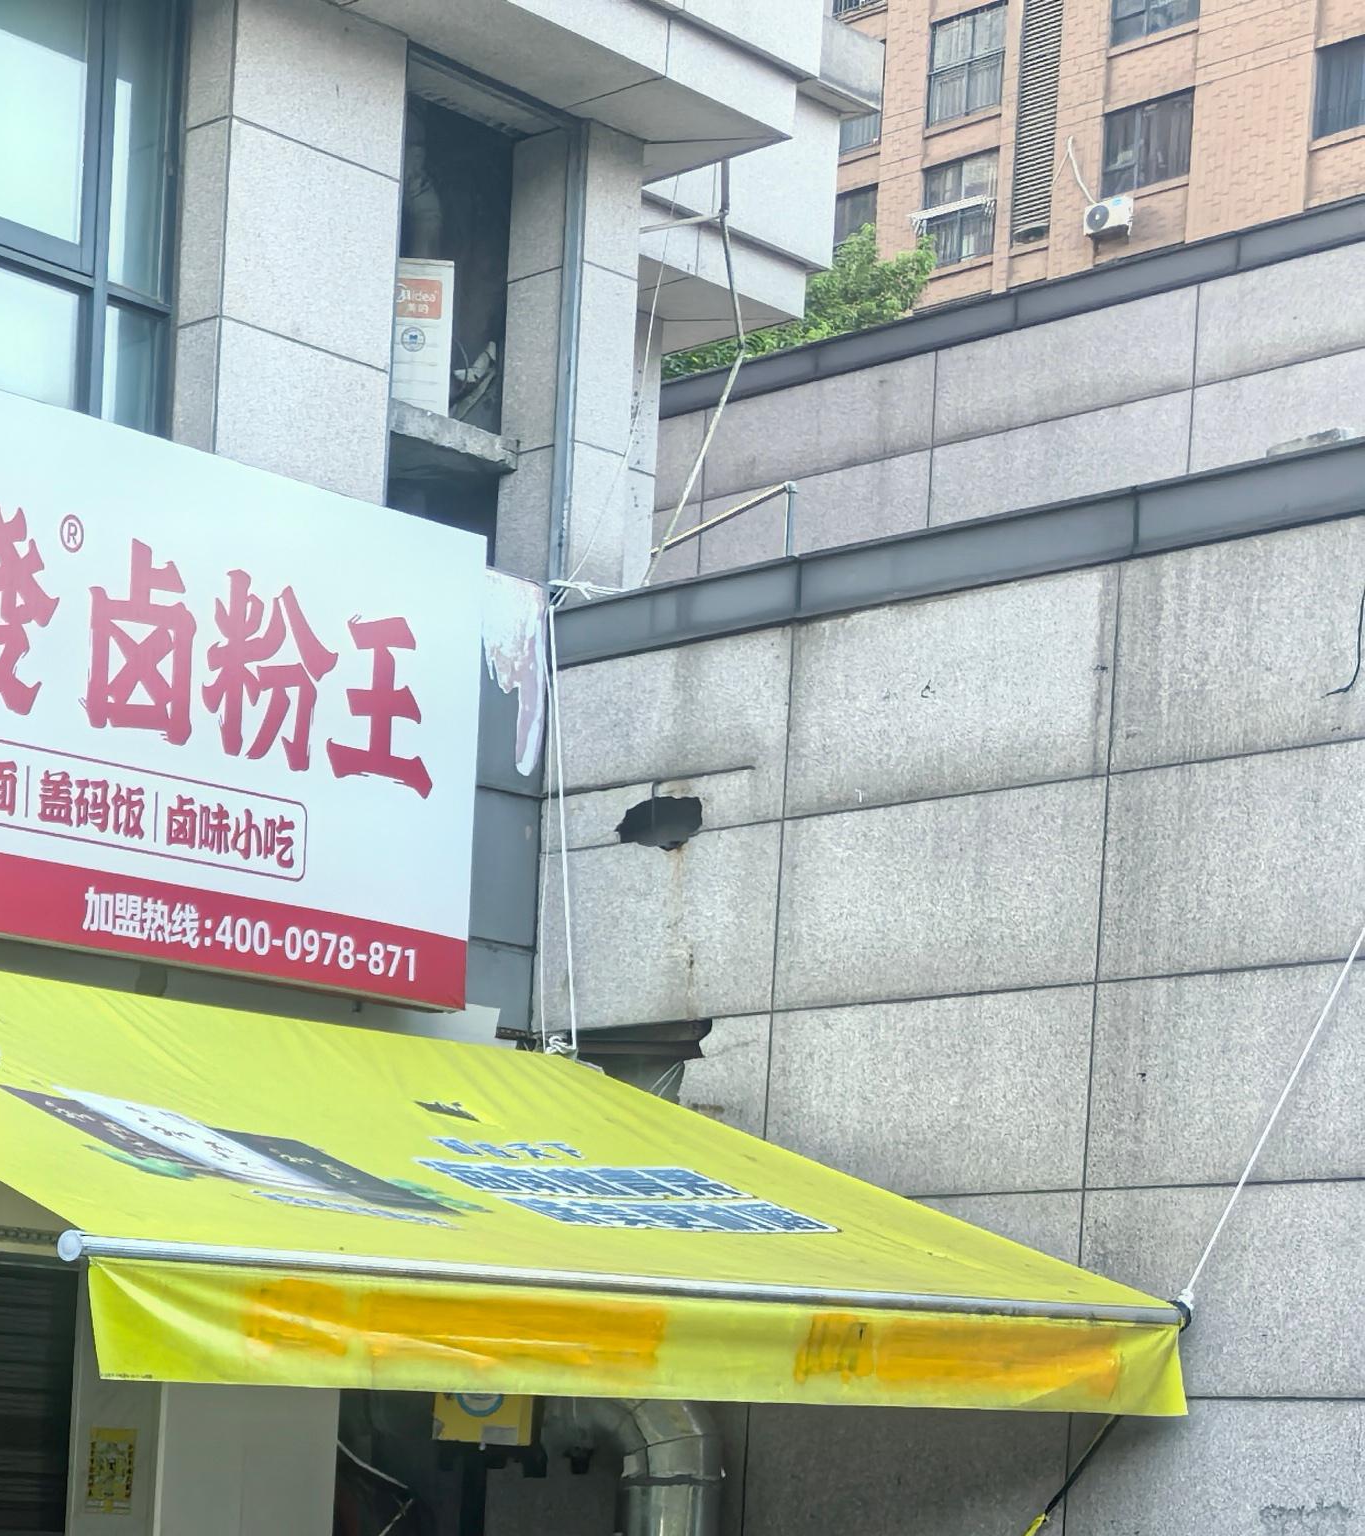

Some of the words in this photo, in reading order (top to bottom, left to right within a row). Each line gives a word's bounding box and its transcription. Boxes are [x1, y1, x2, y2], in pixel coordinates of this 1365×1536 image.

[38, 768, 147, 843] 盖码饭
[165, 790, 297, 873] 卤味小吃
